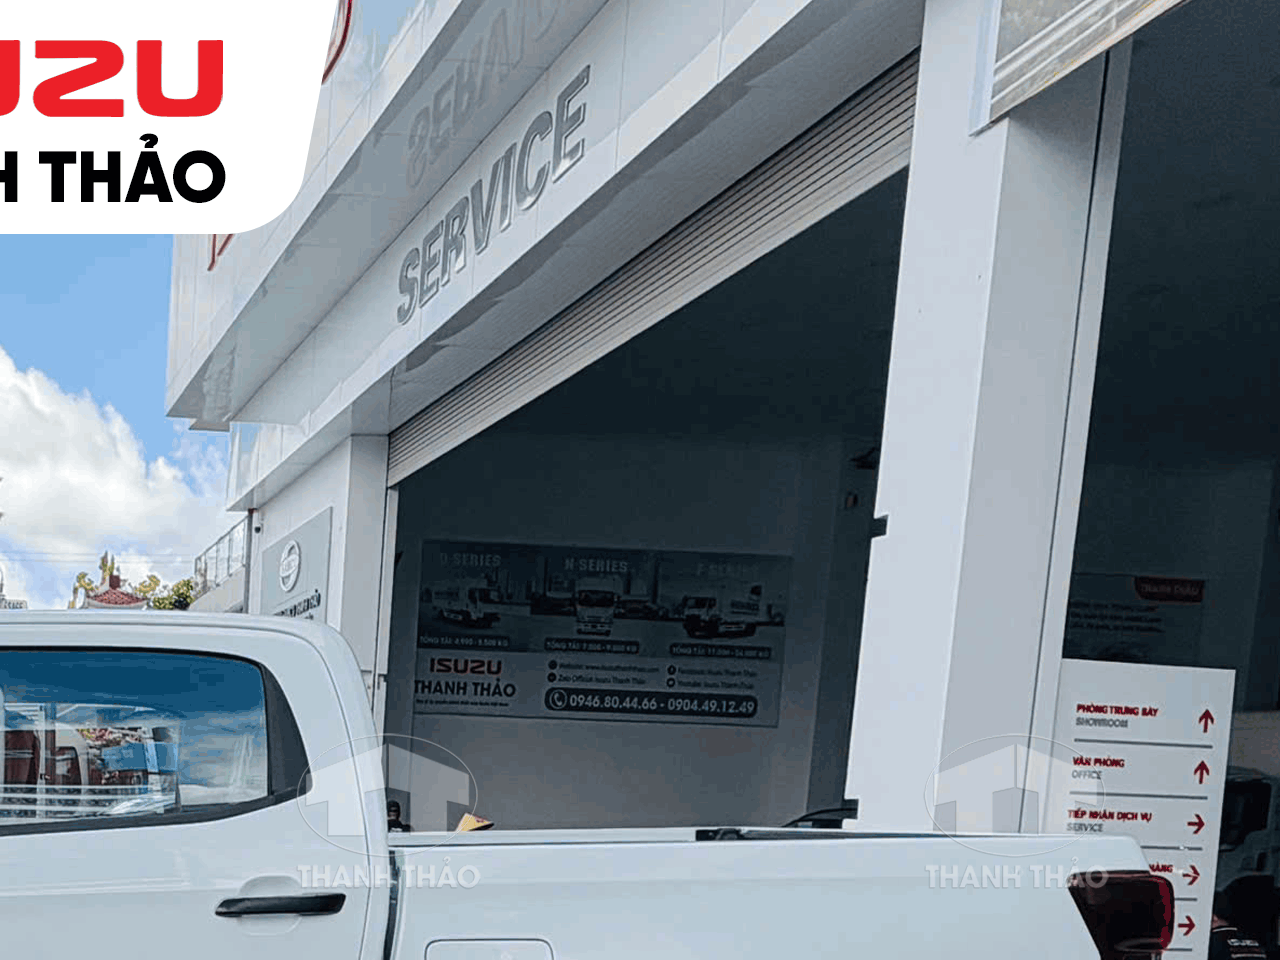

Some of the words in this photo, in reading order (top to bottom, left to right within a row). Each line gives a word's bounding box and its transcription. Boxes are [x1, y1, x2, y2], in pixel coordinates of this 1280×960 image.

[396, 64, 591, 326] SERVICE
[430, 658, 501, 674] ISUZU
[415, 680, 467, 696] THANH
[472, 678, 516, 697] THẢO
[570, 694, 656, 711] 0946.80.44.66
[667, 698, 754, 713] 0904.49.12.49
